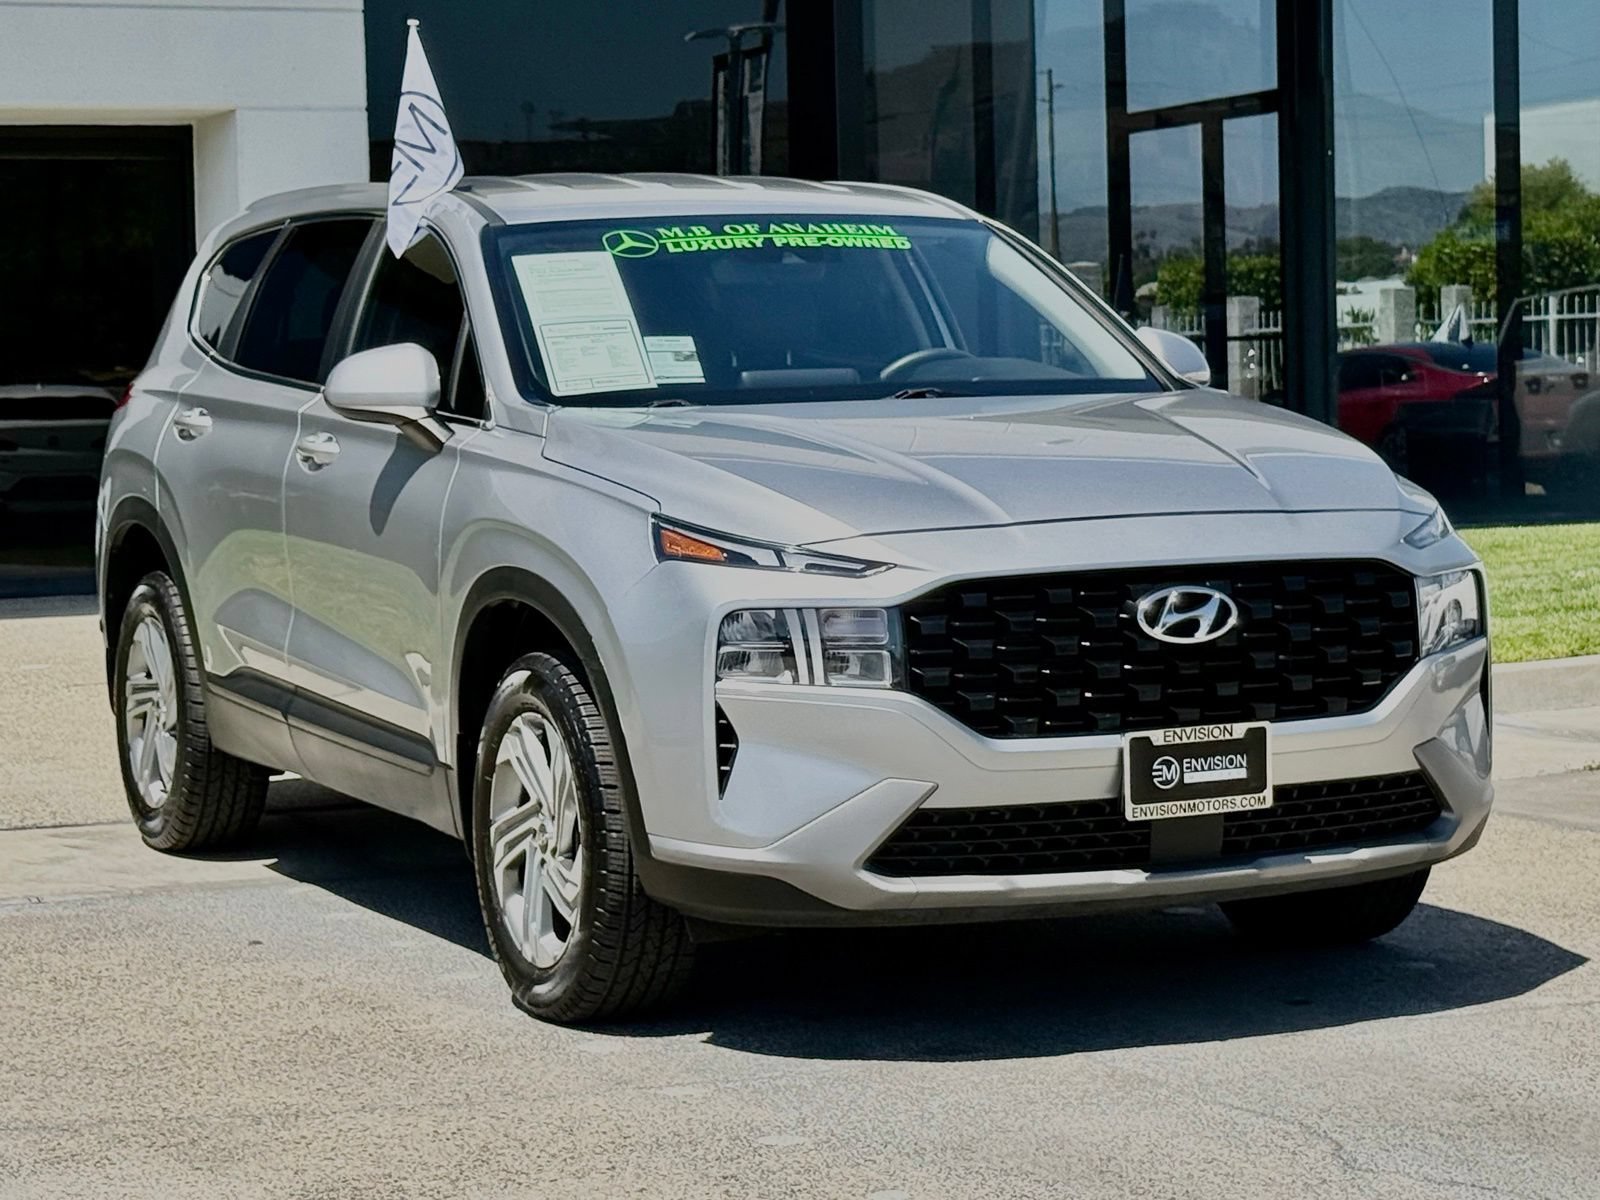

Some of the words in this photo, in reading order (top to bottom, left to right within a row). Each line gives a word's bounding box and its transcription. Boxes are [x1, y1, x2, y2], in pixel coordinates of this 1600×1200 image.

[722, 223, 761, 235] OF
[769, 223, 898, 236] ANAHEIM
[664, 236, 764, 253] LUXURY
[772, 235, 912, 250] PRE-OWNED
[1163, 724, 1234, 743] ENVISION
[1183, 753, 1248, 773] ENVISION
[1131, 795, 1267, 819] ENVISIONMOTORS.COM
